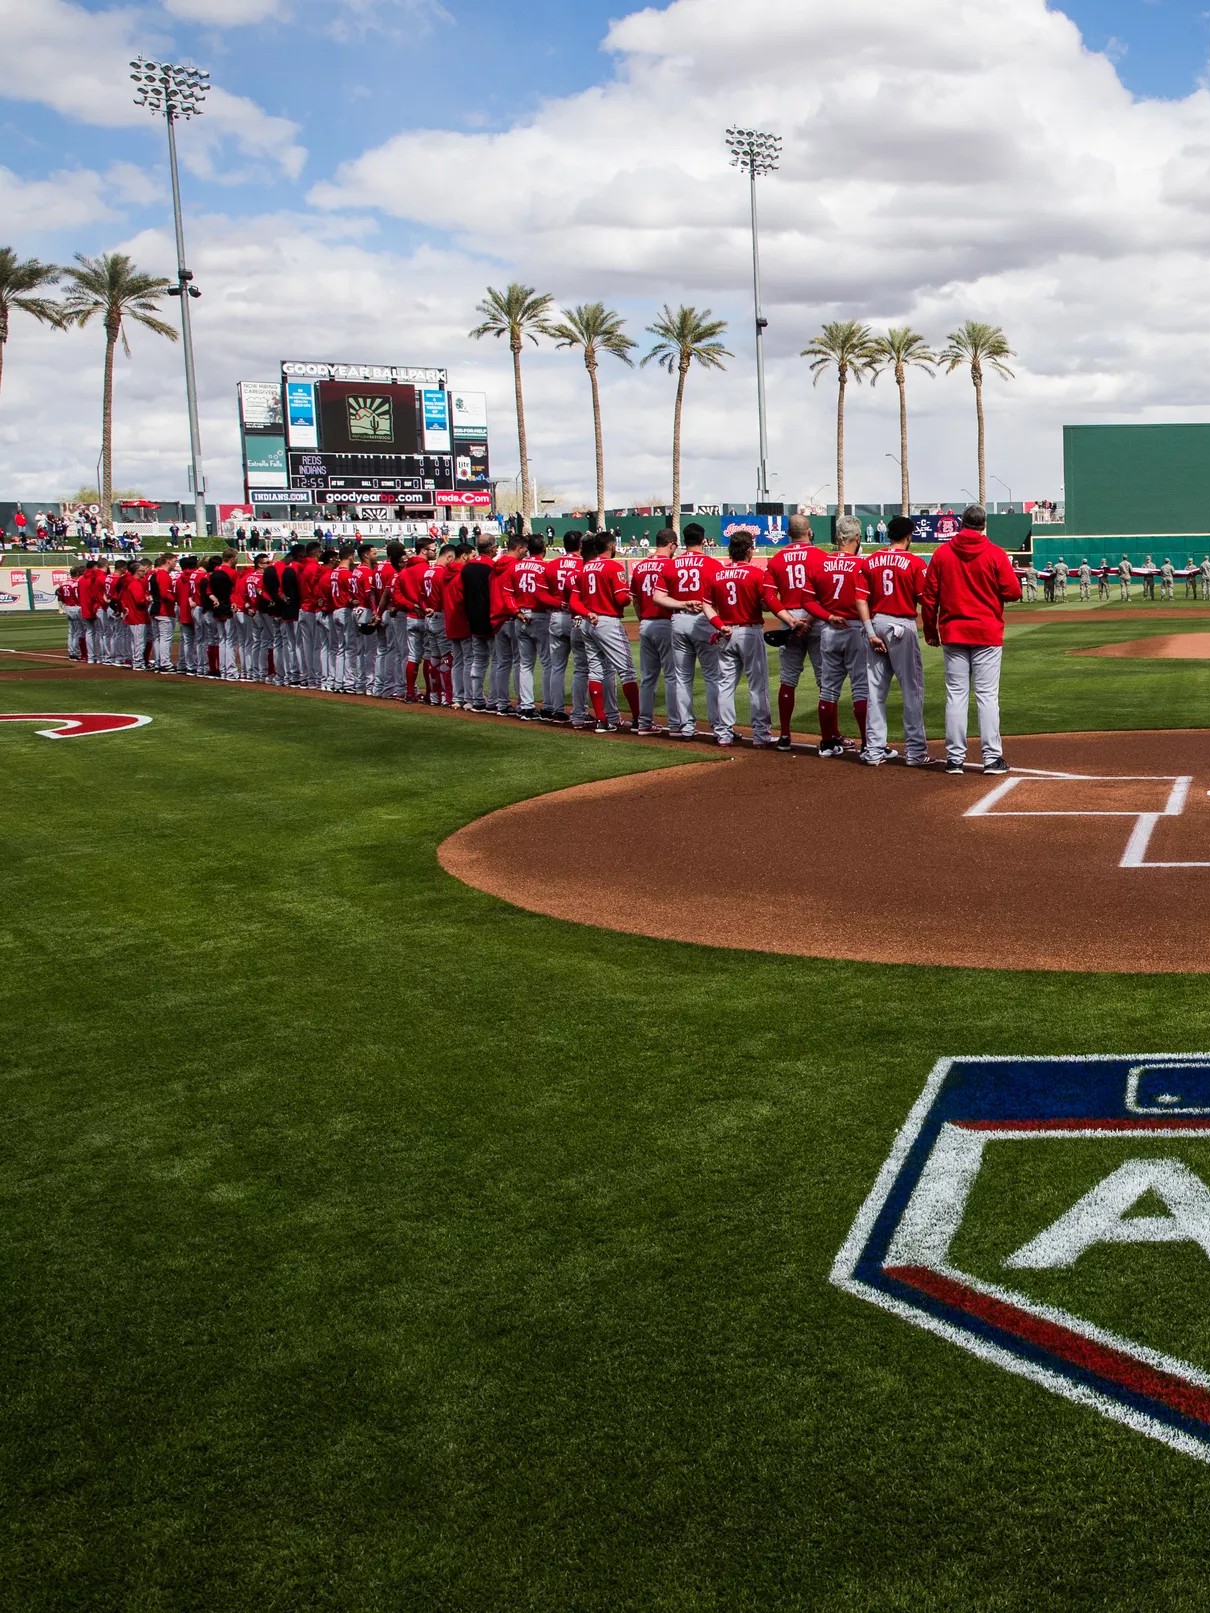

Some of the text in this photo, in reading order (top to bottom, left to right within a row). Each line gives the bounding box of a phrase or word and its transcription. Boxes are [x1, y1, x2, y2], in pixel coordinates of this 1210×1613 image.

[282, 362, 446, 382] GOODYEAR BALLPARK
[247, 459, 269, 467] Estrella
[302, 455, 322, 465] REDS
[299, 465, 327, 475] INDIANS
[296, 478, 325, 488] 12:55
[253, 493, 308, 501] INDIANS.COM
[326, 491, 423, 503] goodyearbp.com
[559, 559, 577, 570] LONG
[674, 556, 704, 570] DUVALL
[783, 551, 808, 564] VOTTO
[868, 555, 911, 571] HAMILTON
[518, 573, 536, 593] 45
[677, 568, 701, 593] 23
[715, 569, 750, 583] GENNETT
[784, 563, 806, 590] 19
[881, 569, 894, 597] 6
[588, 573, 597, 595] 9
[832, 573, 845, 600] 7
[725, 581, 738, 606] 3
